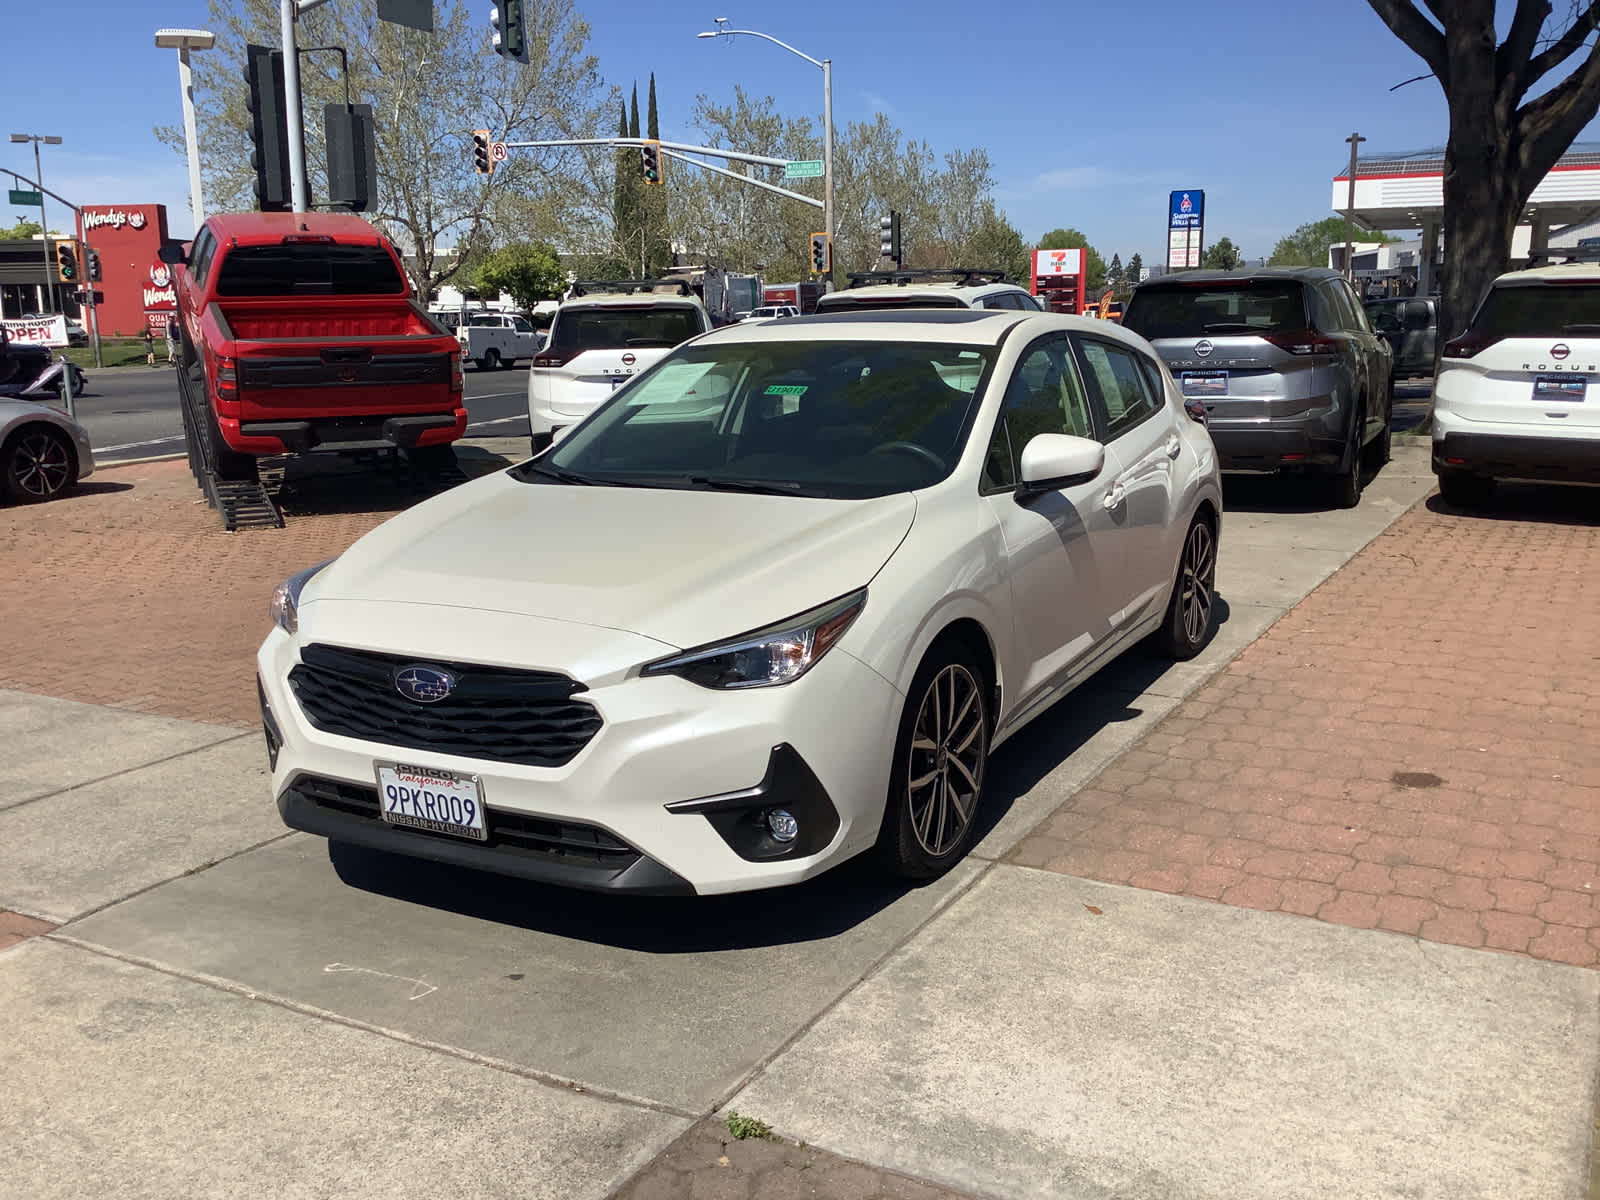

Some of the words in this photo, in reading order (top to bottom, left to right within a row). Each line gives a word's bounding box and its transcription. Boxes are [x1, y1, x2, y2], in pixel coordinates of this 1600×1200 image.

[84, 208, 126, 229] Wendy's
[1522, 363, 1596, 371] ROGUE
[398, 763, 453, 780] CHICO
[397, 773, 455, 789] California
[386, 785, 476, 827] 9PKR009
